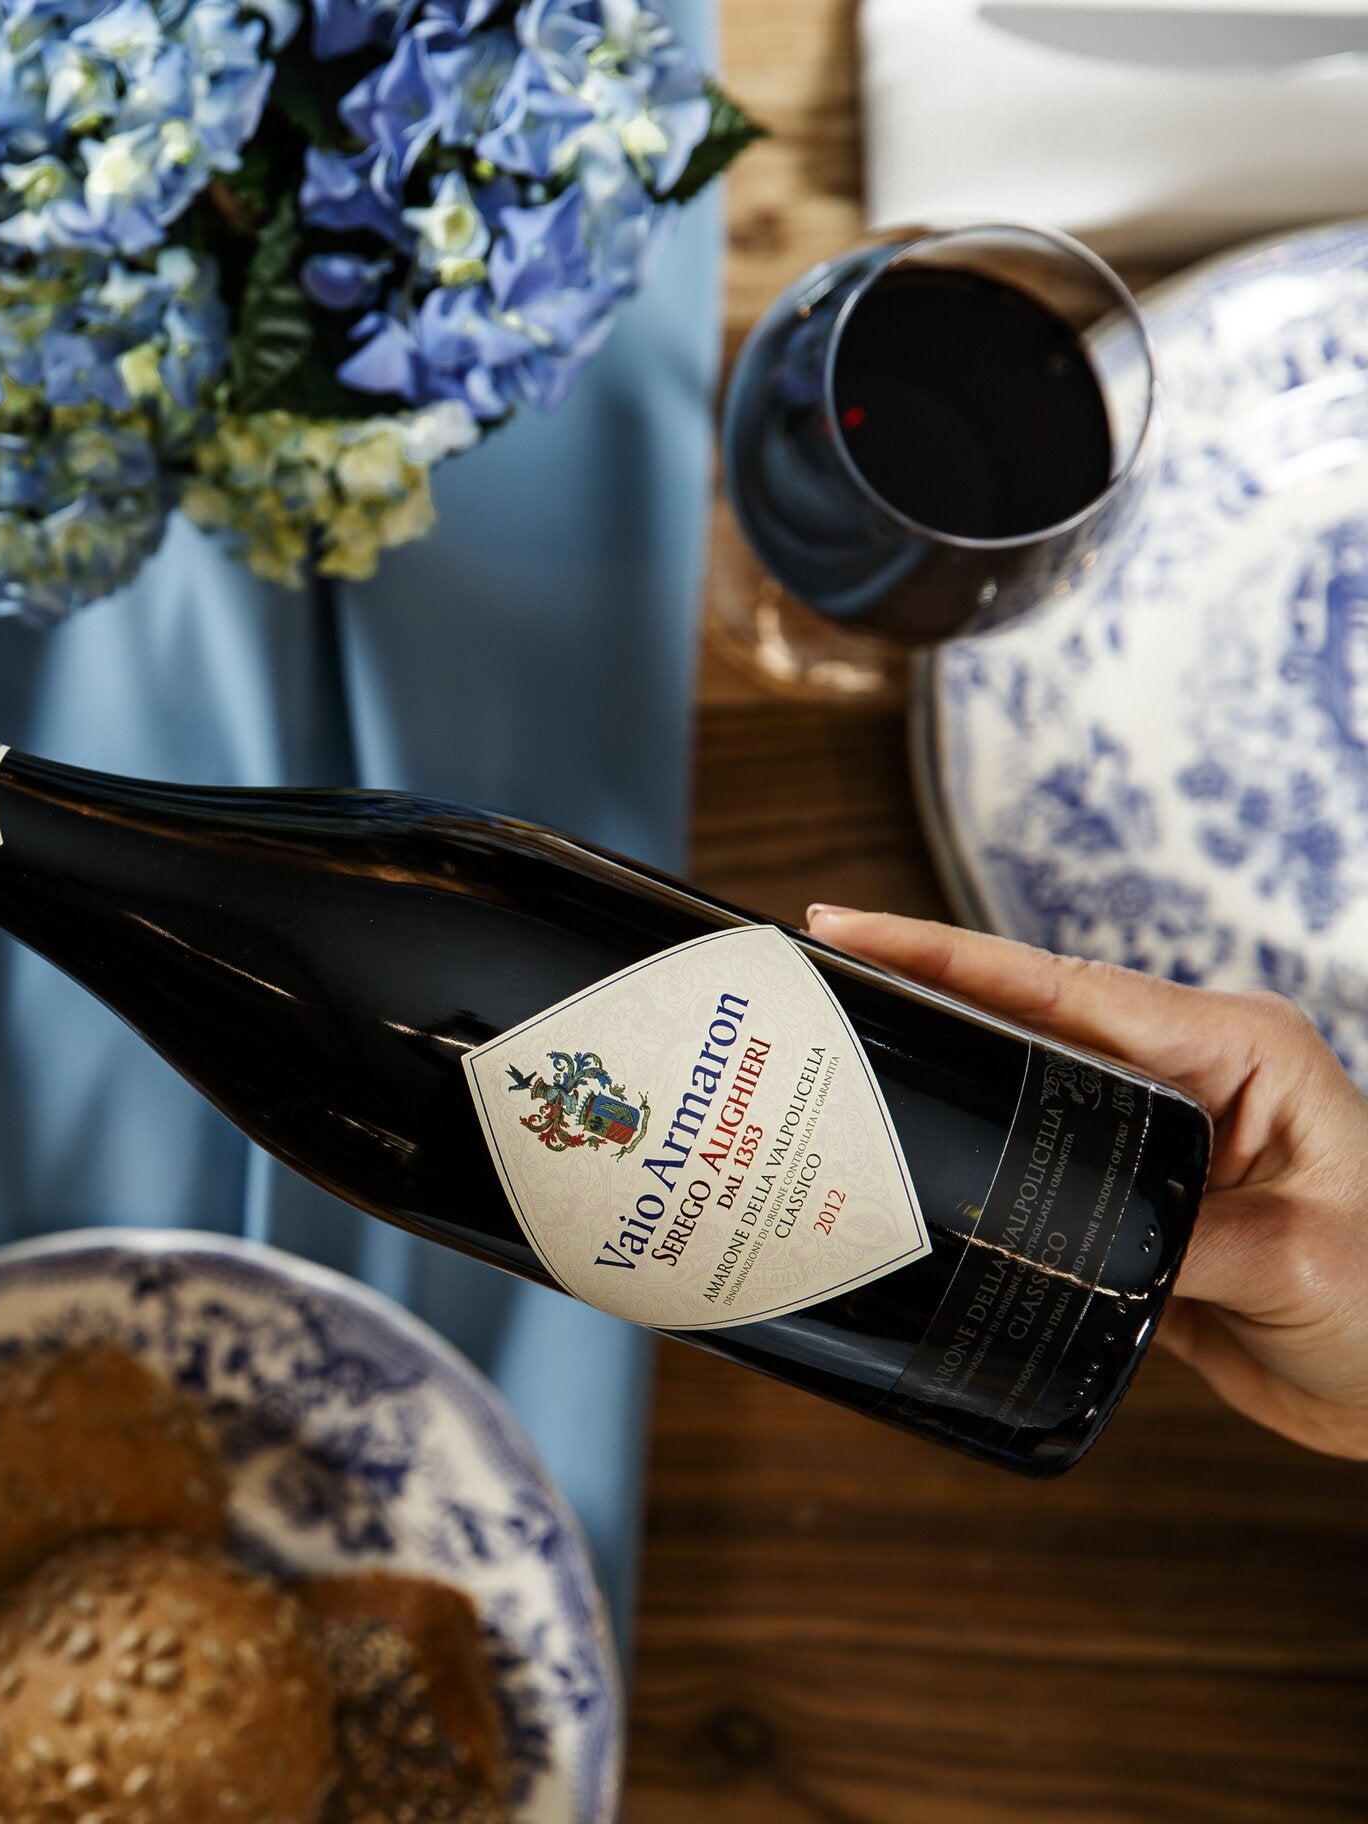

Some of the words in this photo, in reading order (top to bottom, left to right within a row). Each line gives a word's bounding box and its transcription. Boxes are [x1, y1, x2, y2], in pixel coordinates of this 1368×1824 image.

[814, 1056, 840, 1107] GARANTITA
[593, 1193, 666, 1270] Vaio
[640, 992, 750, 1194] Armaron
[811, 1107, 821, 1115] E
[1113, 1120, 1129, 1149] ITALY
[650, 1179, 712, 1268] SEREGO
[698, 1035, 772, 1176] ALIGHIERI
[701, 1228, 751, 1304] AMARONE
[740, 1174, 777, 1227] DELLA
[764, 1047, 827, 1167] VALPOLICELLA
[716, 1174, 745, 1211] DAL
[733, 1123, 764, 1170] 1353
[782, 1116, 818, 1186] CONTROLLATA
[1049, 1133, 1076, 1188] GARANTITA
[1110, 1148, 1122, 1165] OF
[763, 1185, 789, 1228] ORIGINE
[774, 1152, 822, 1239] CLASSICO
[812, 1189, 847, 1236] 2012
[965, 1254, 1011, 1323] DELLA
[997, 1108, 1064, 1251] VALPOLICELLA
[1046, 1188, 1057, 1196] E
[1092, 1163, 1119, 1220] PRODUCT
[757, 1227, 770, 1240] DI
[1016, 1198, 1054, 1274] CNTROLLATA
[1079, 1220, 1100, 1252] WINE
[721, 1239, 764, 1307] DENOMINAZIONE
[995, 1273, 1023, 1320] ORIGINE
[1007, 1231, 1068, 1340] CLASSCO
[987, 1319, 1001, 1333] DI
[1040, 1326, 1055, 1342] IN
[1047, 1291, 1073, 1327] ITALIA
[1009, 1343, 1046, 1397] PRODOTTO
